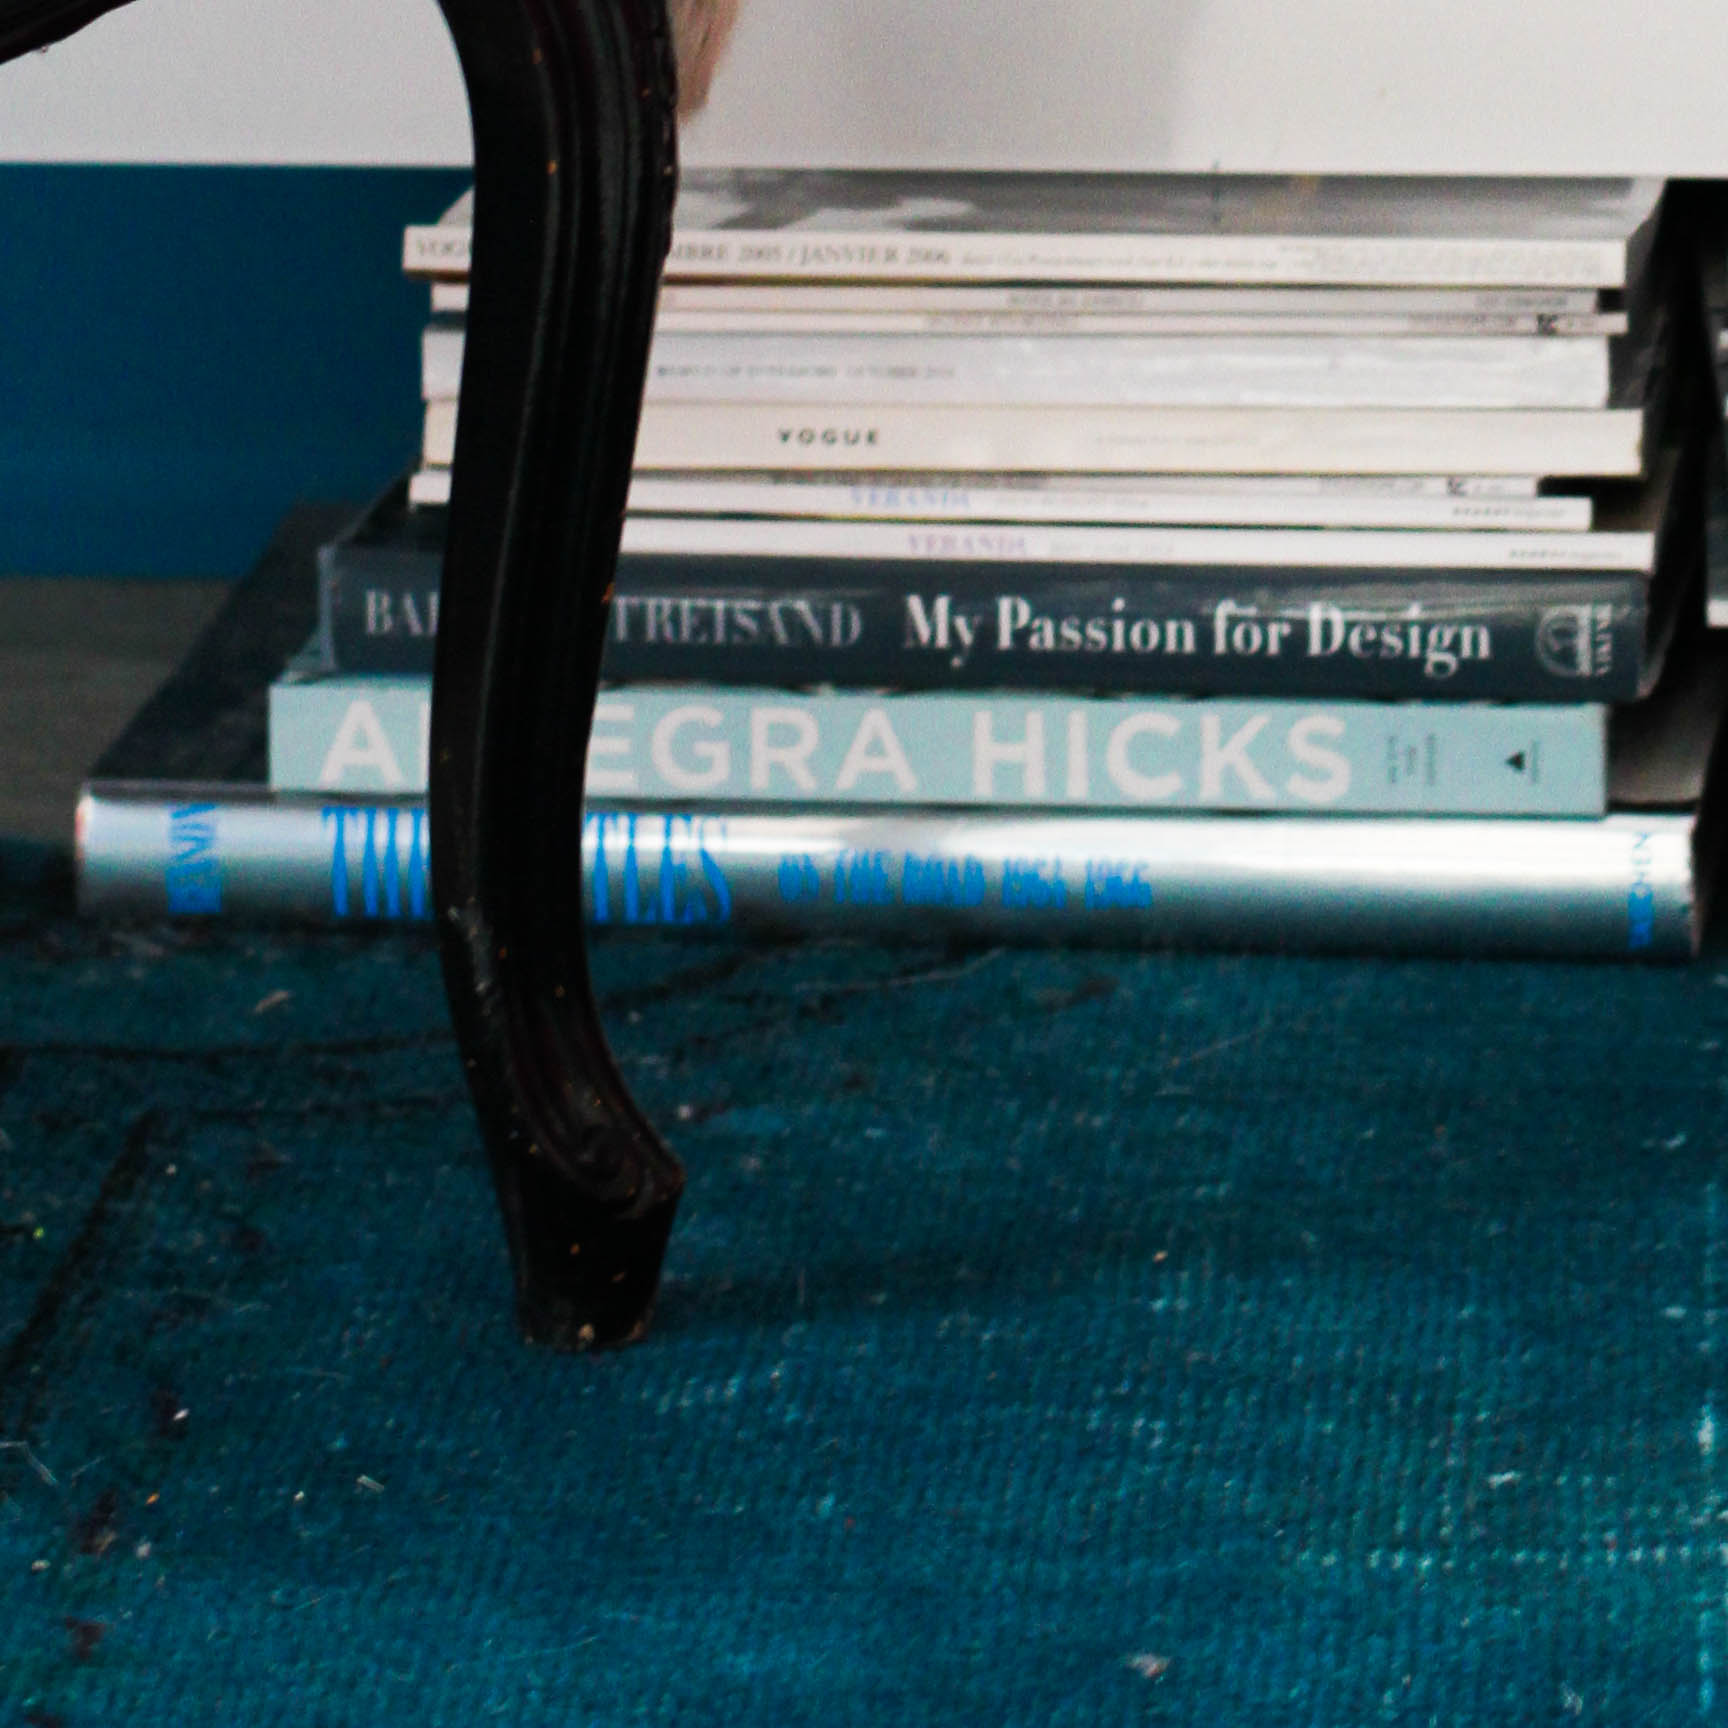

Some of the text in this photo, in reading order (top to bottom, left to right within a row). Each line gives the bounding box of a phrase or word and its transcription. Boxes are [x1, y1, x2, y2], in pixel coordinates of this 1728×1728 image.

[778, 428, 880, 445] VOGUE
[616, 594, 862, 648] TREISAND
[905, 594, 1493, 676] My Passion for Design
[318, 698, 920, 792] AEGRA
[970, 709, 1355, 802] HICKS
